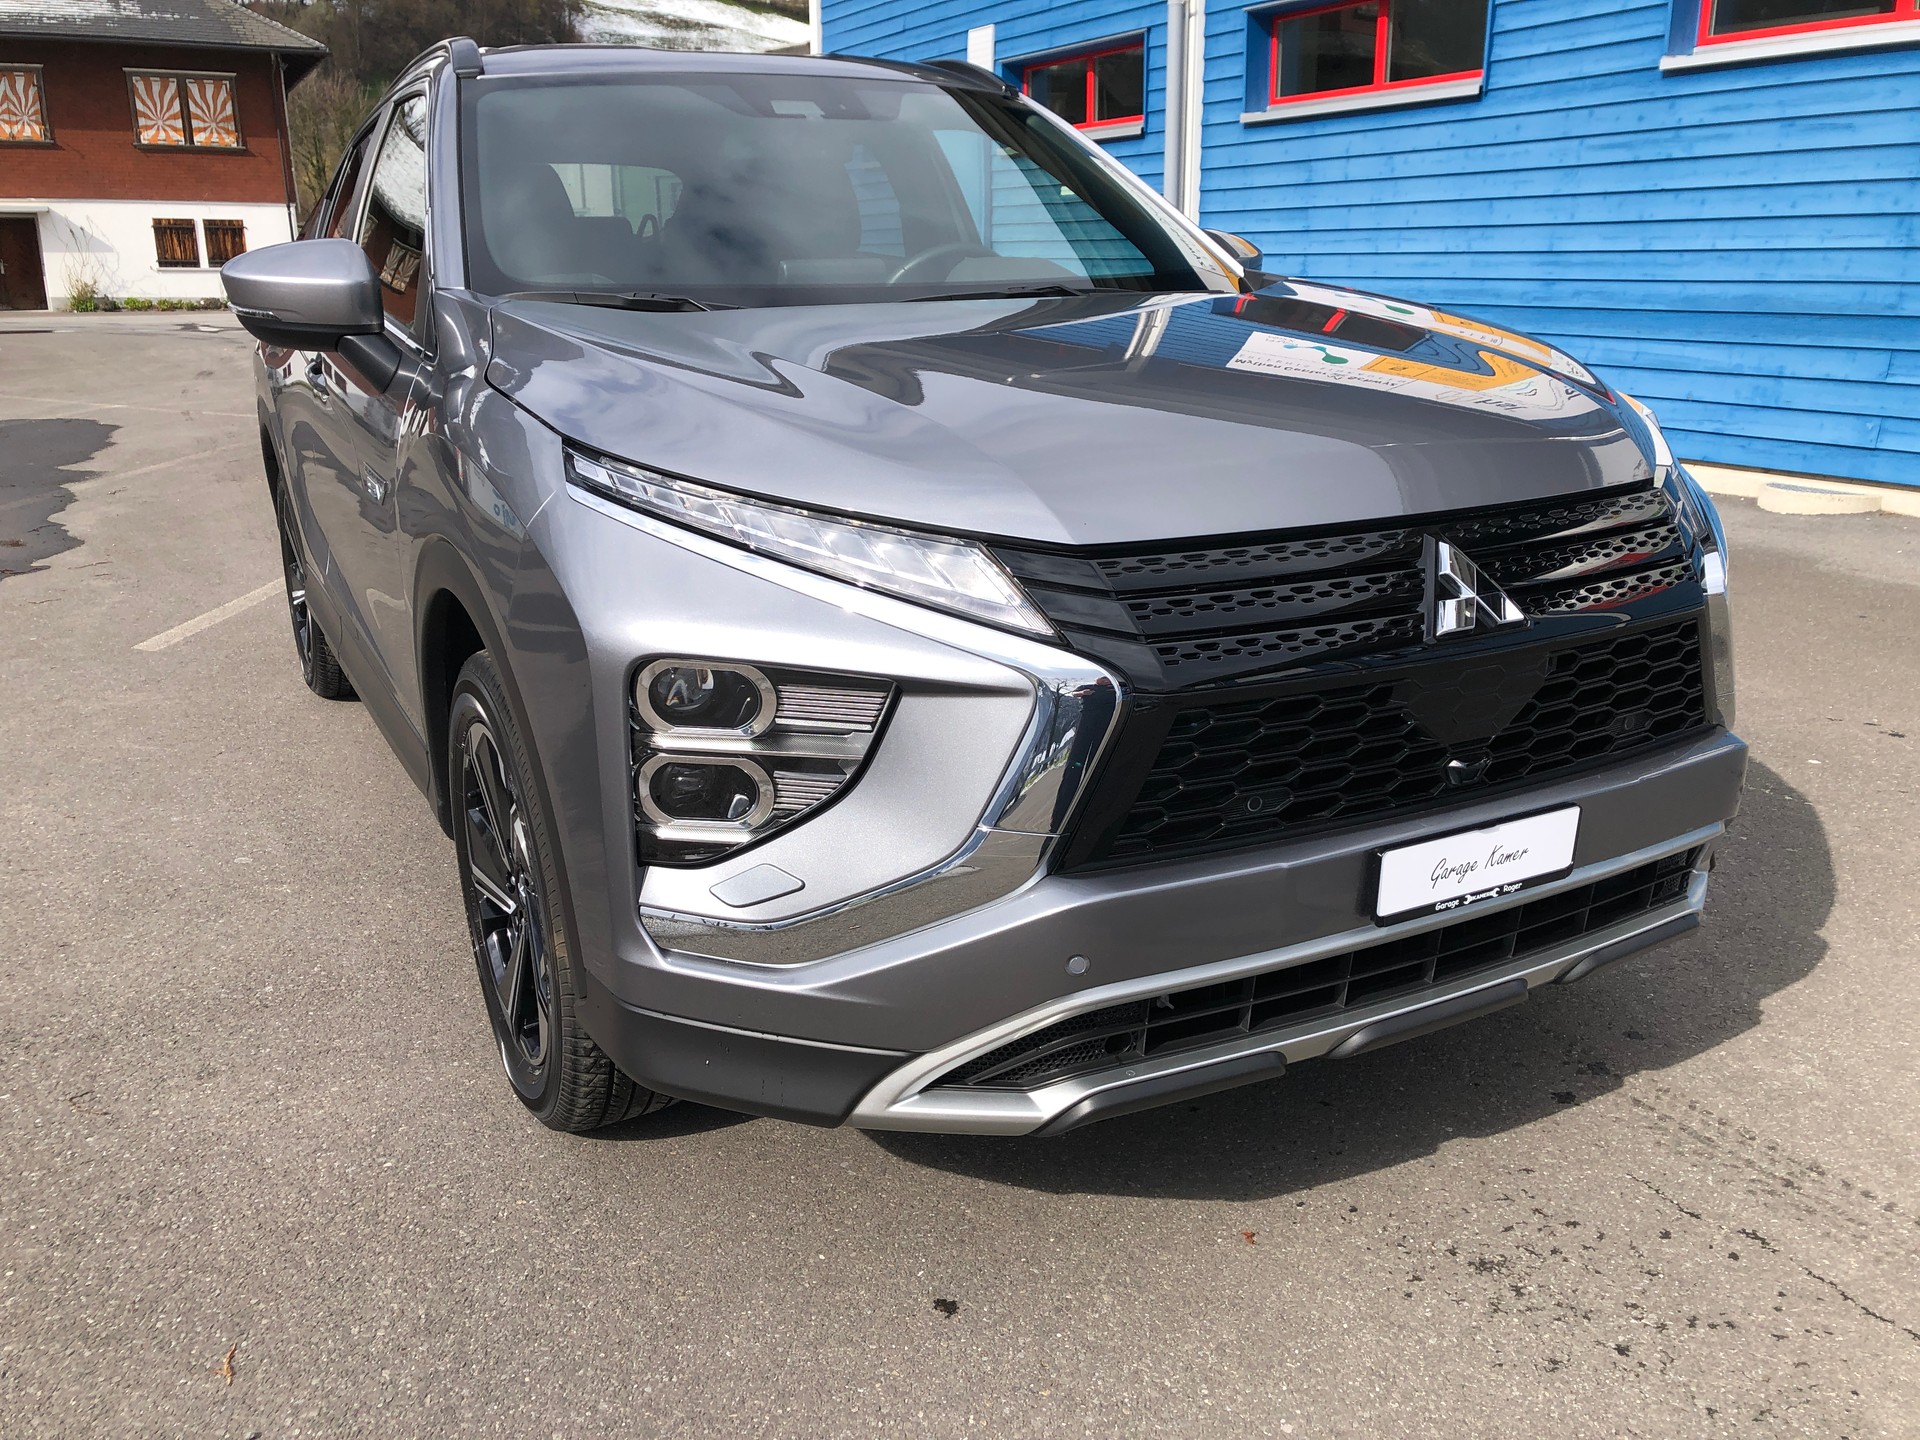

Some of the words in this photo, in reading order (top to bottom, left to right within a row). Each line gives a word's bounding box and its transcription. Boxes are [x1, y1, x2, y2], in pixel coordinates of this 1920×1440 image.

[1431, 858, 1478, 889] Garage
[1485, 845, 1529, 869] Kamer
[1435, 899, 1459, 911] Garage
[1503, 883, 1522, 893] Roger
